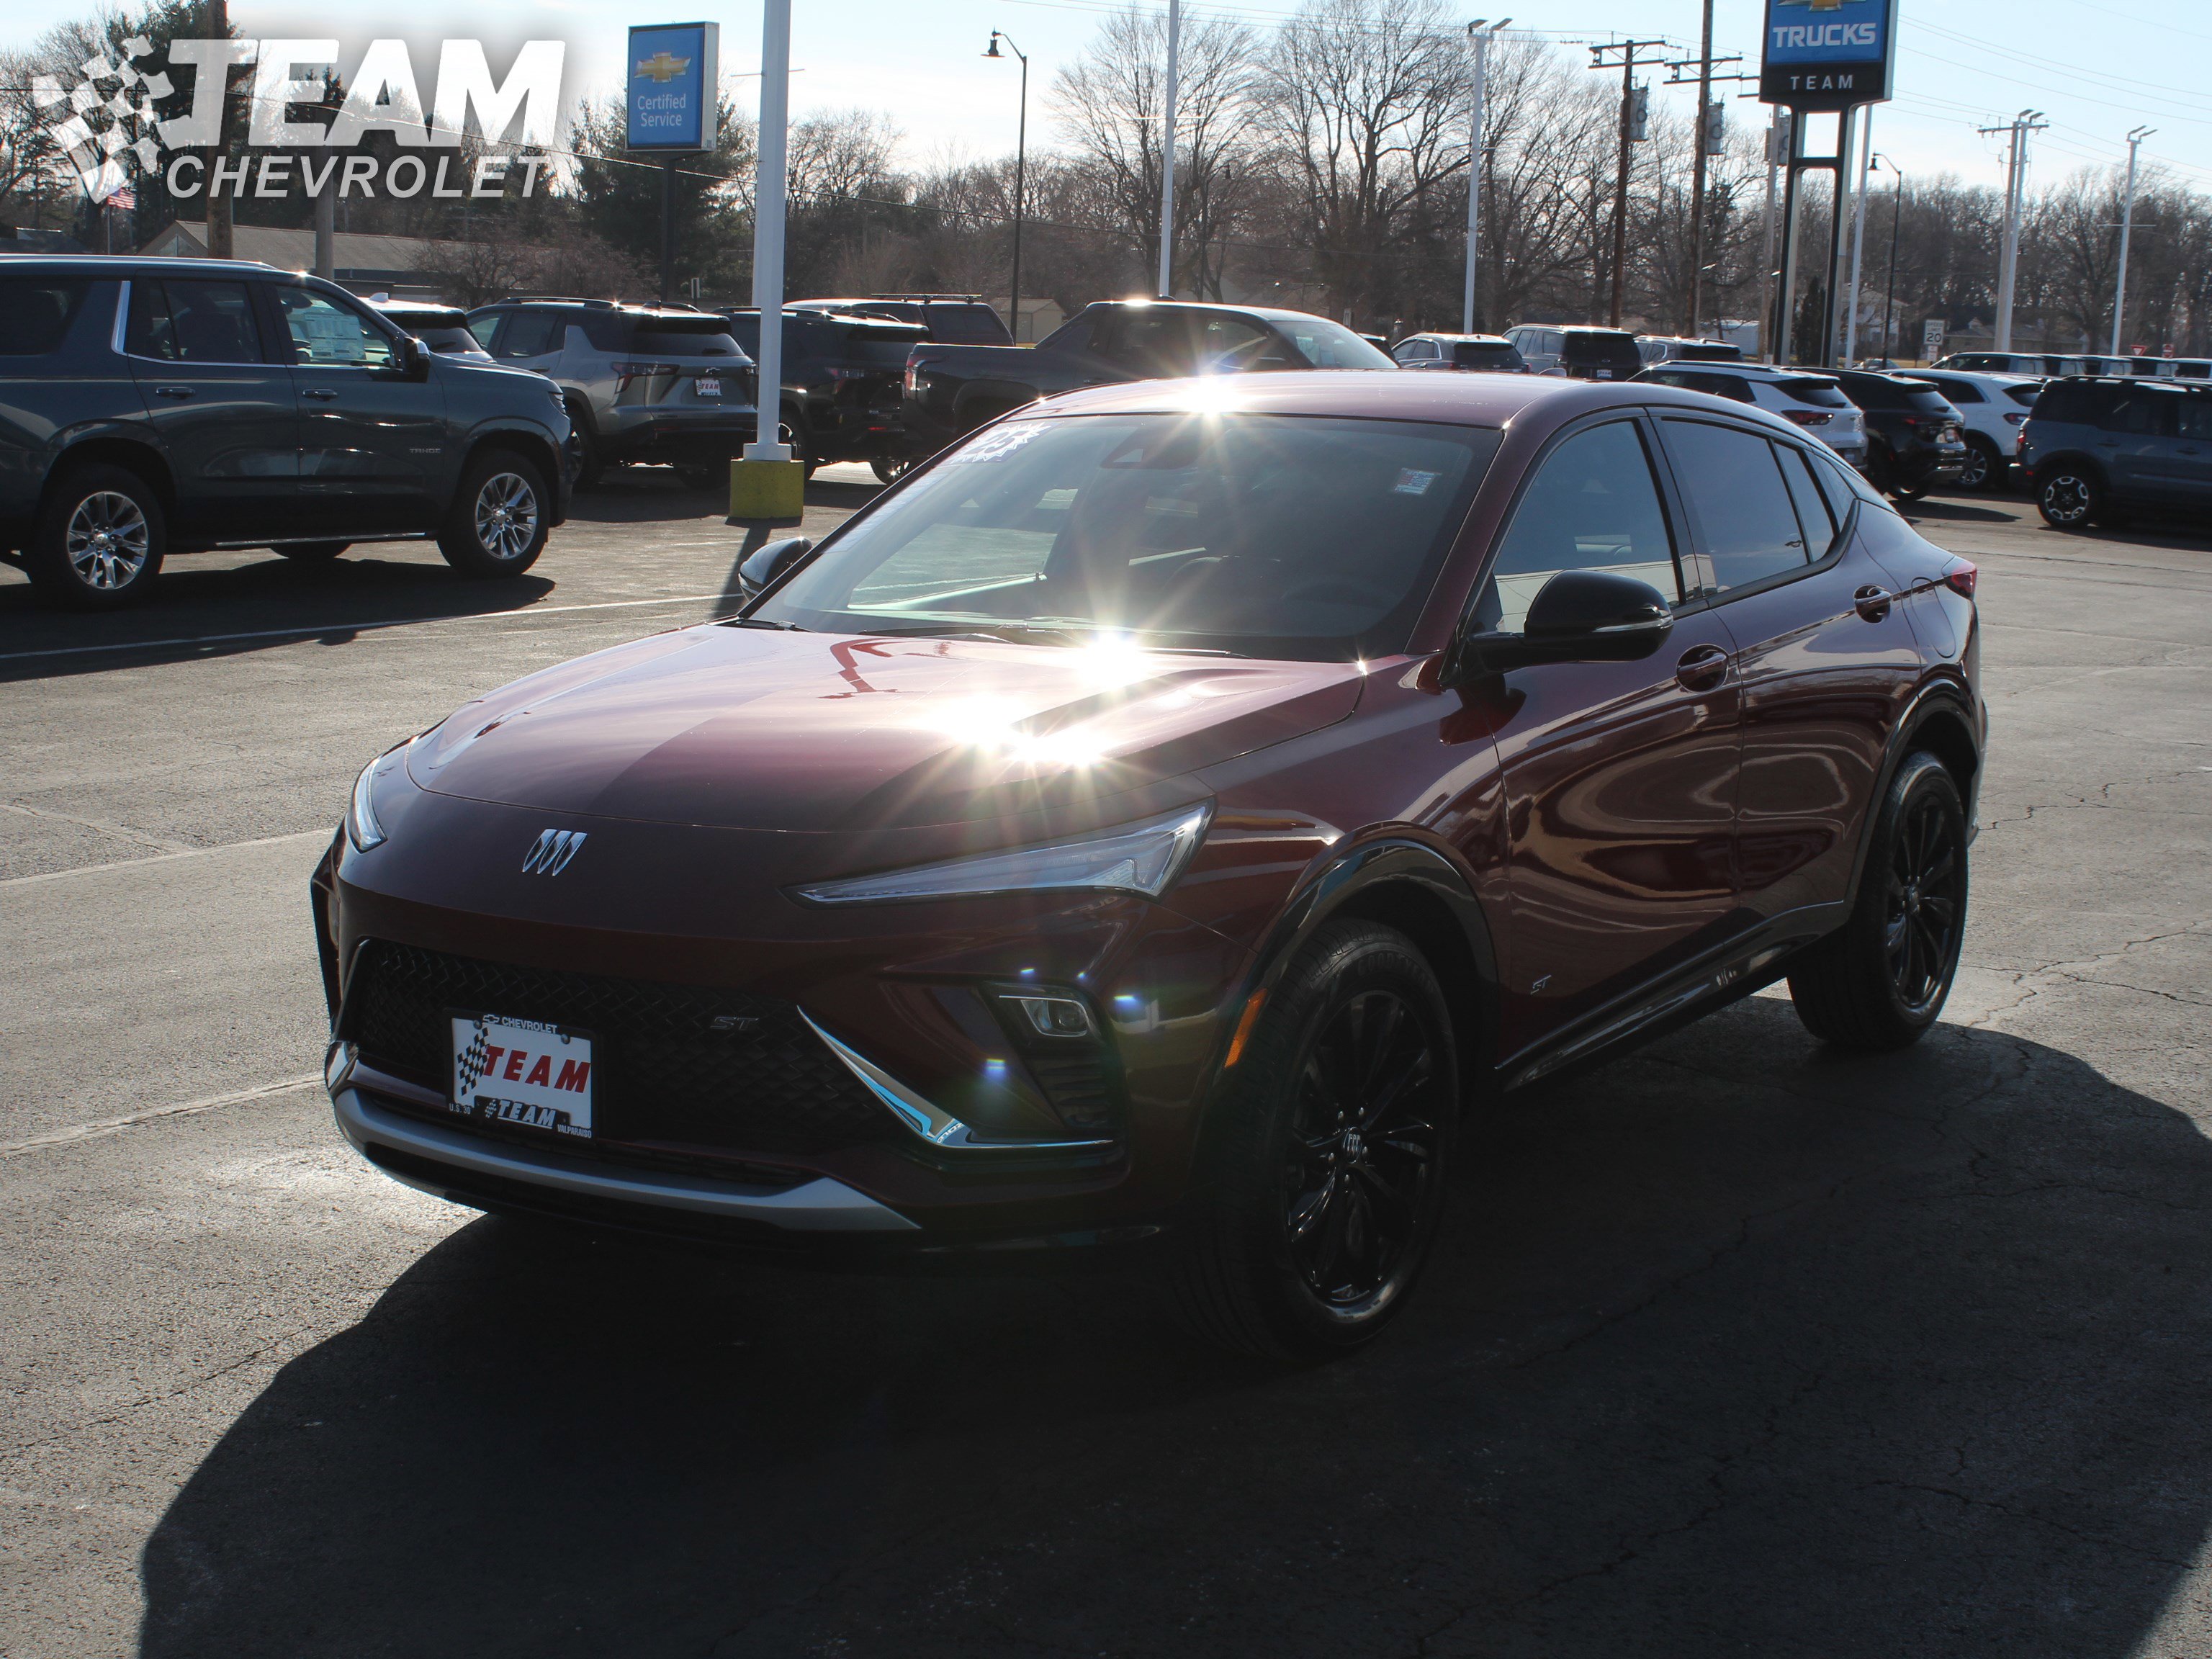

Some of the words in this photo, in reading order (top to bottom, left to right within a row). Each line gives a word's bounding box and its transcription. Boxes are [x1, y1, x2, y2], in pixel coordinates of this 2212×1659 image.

[1773, 23, 1876, 48] TRUCKS
[1790, 75, 1853, 90] TEAM
[637, 94, 687, 110] Certified
[640, 112, 683, 127] Service
[1926, 333, 1941, 342] 20
[502, 1017, 557, 1034] CHEVROLET
[484, 1046, 590, 1093] TEAM
[449, 1103, 462, 1113] U.S.
[463, 1106, 471, 1115] 30
[498, 1099, 557, 1128] TEAM
[557, 1124, 592, 1138] VALPARAISO
